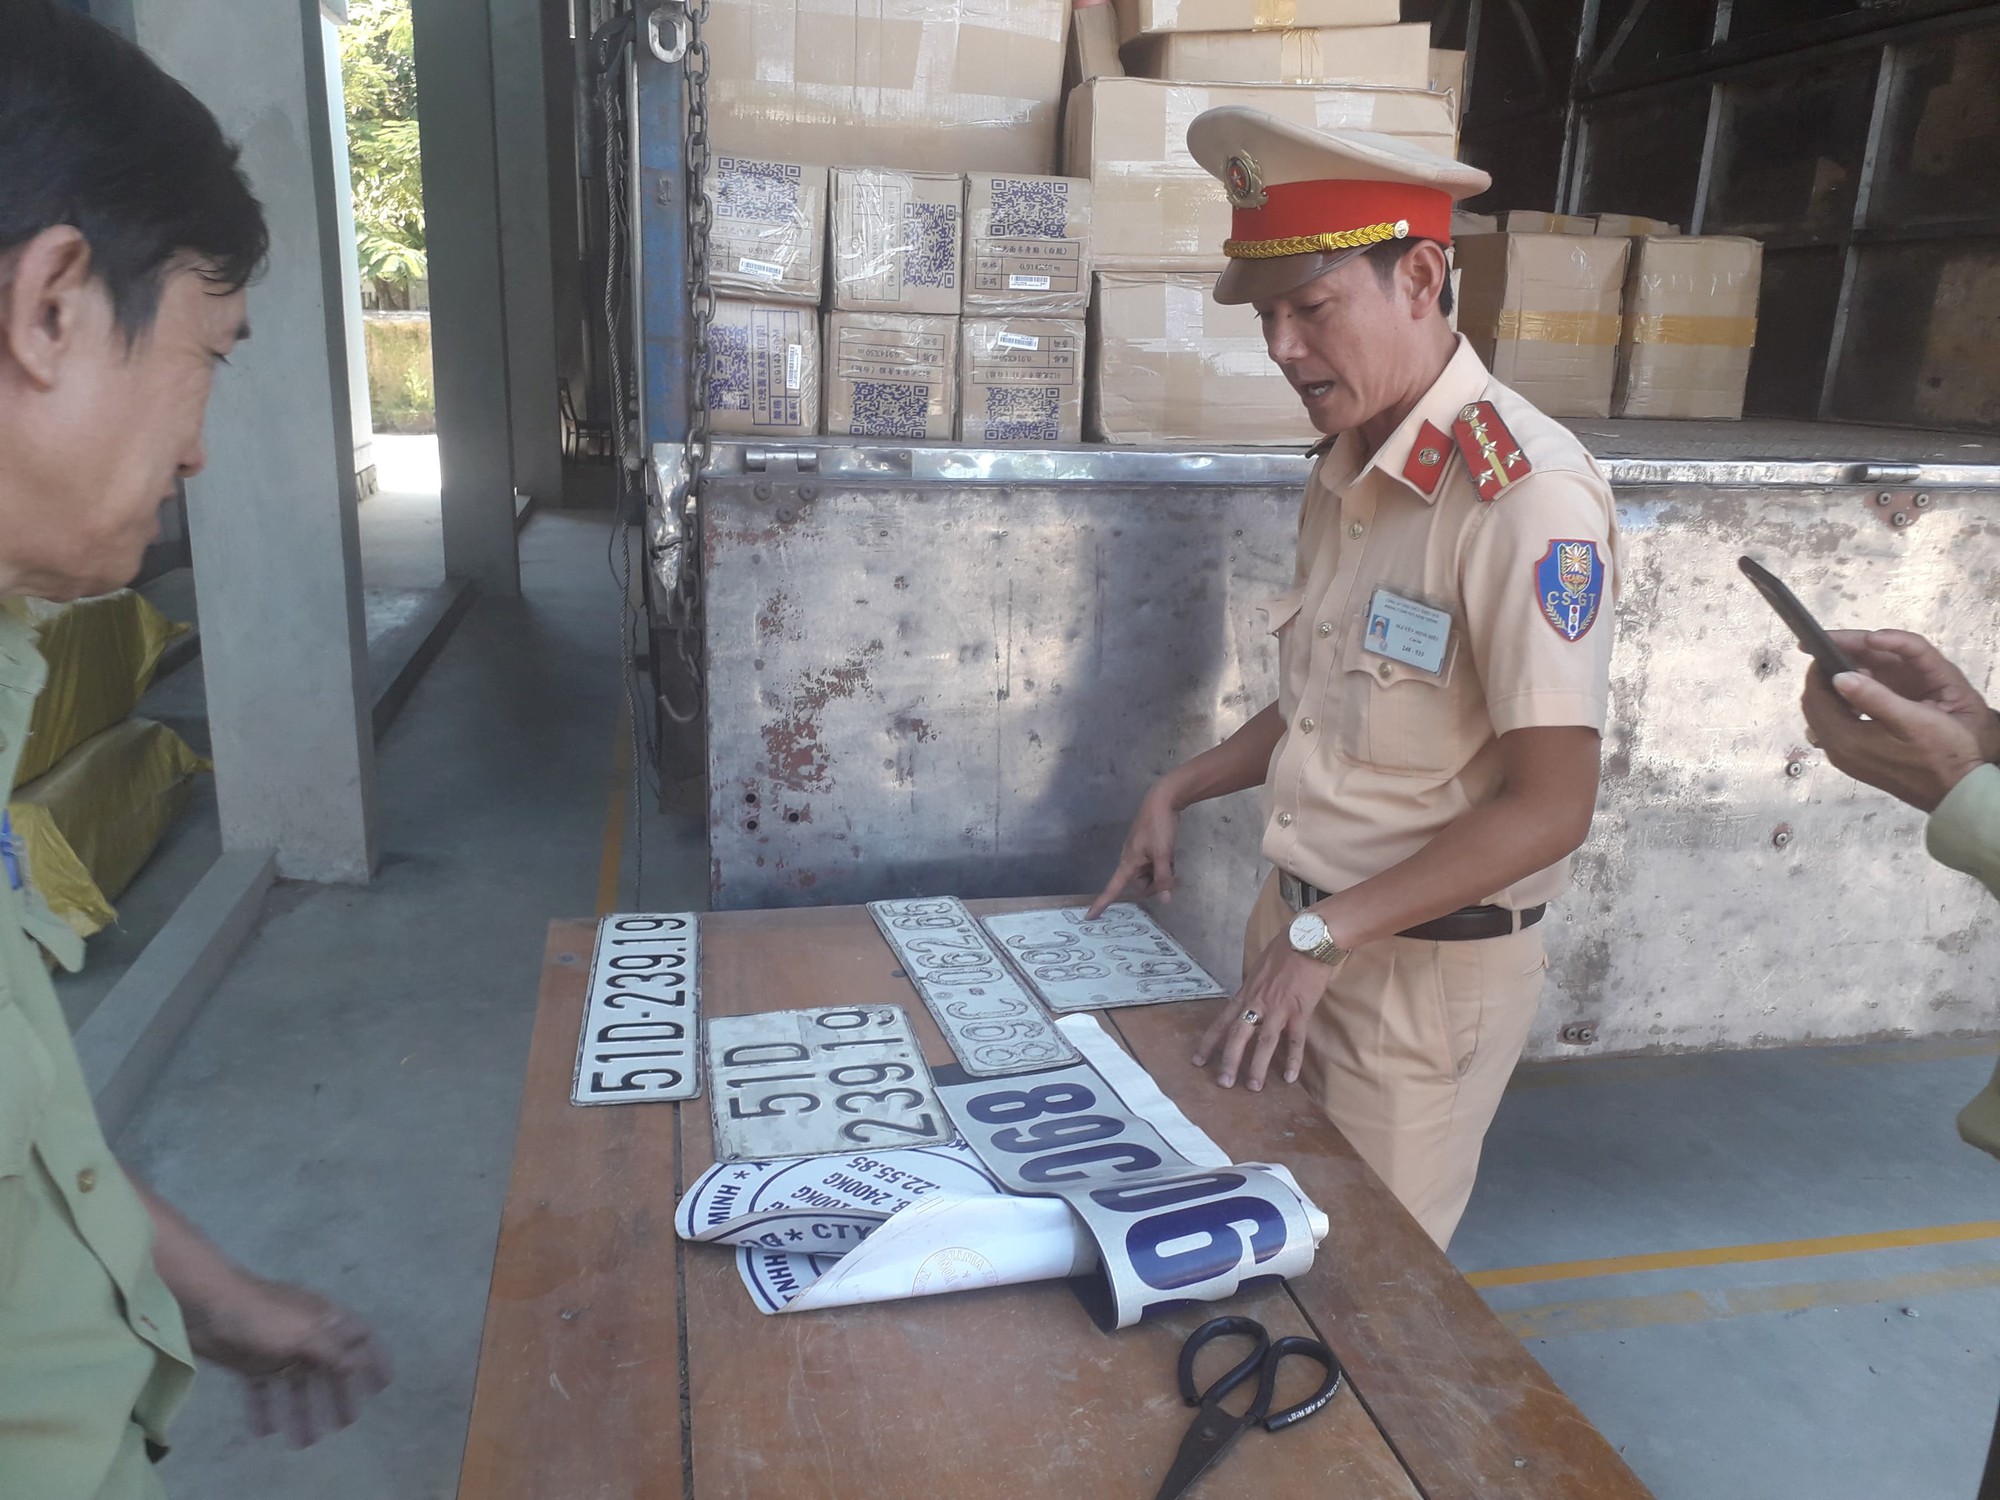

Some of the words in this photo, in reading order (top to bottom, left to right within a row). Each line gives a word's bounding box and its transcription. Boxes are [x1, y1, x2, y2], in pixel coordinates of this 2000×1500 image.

[1006, 930, 1111, 982] 89C
[590, 917, 688, 1094] 51D-239.19
[723, 1041, 821, 1120] 51D
[815, 1009, 939, 1144] 239.19
[707, 1184, 742, 1226] MINH
[822, 1171, 893, 1206] 2400KG
[811, 1223, 873, 1240] CTY
